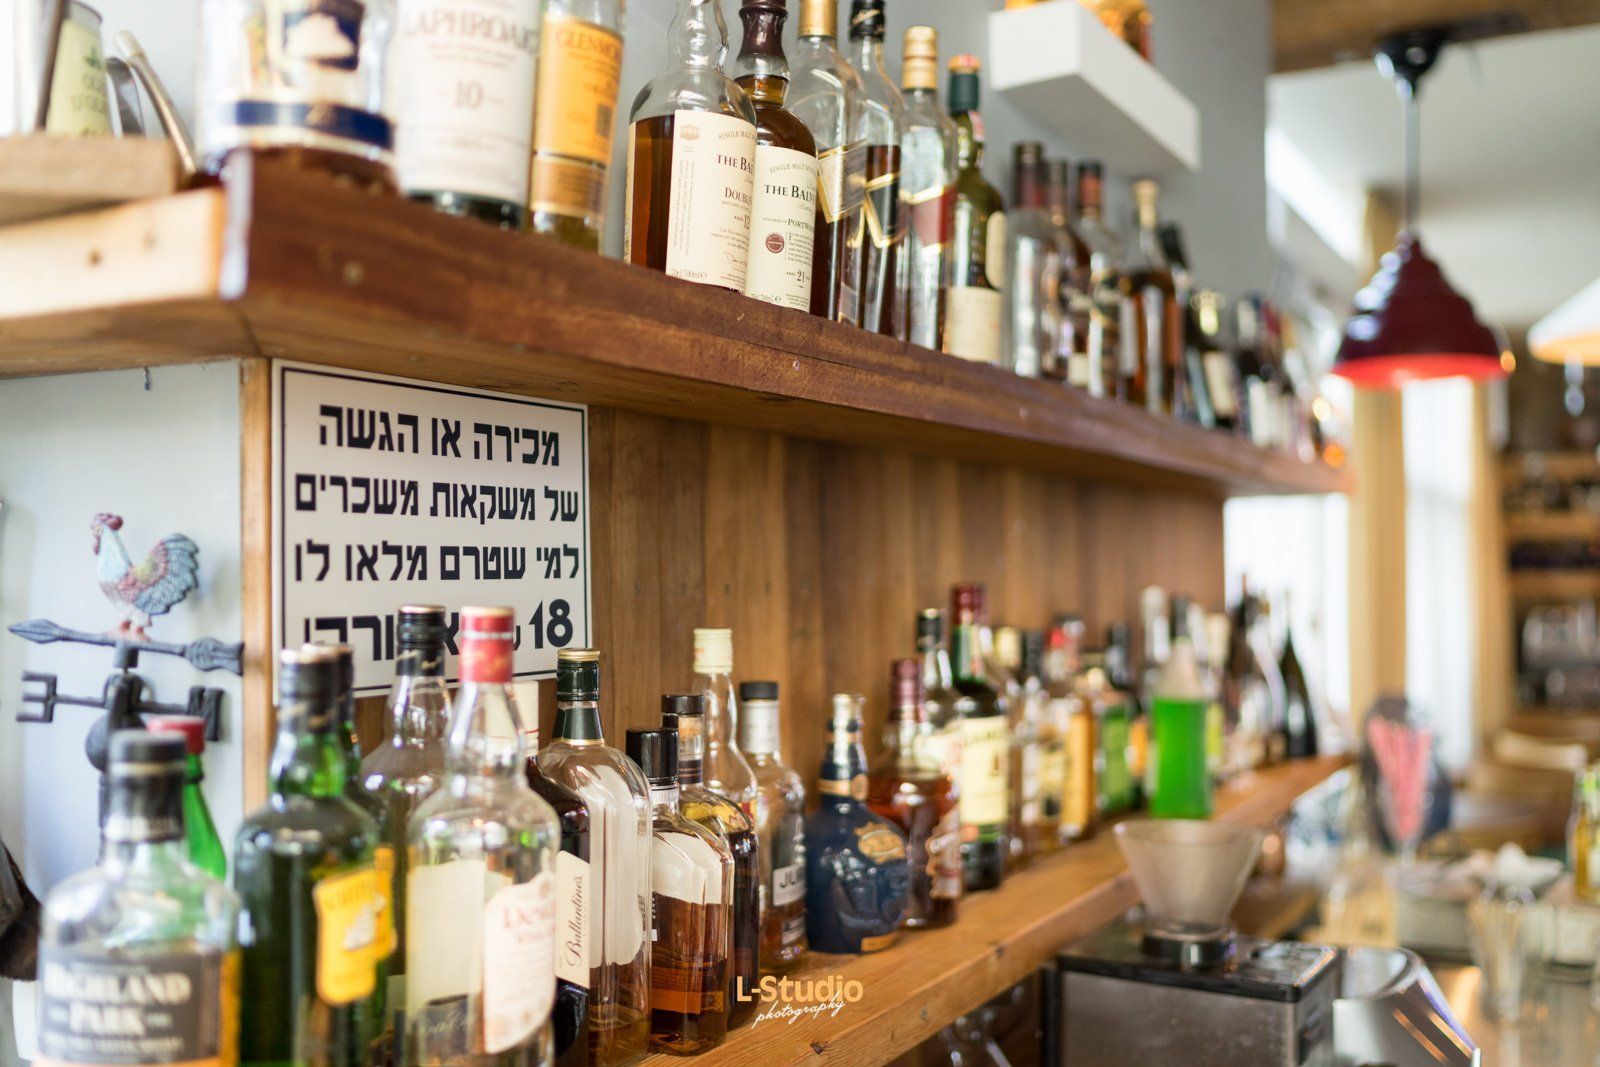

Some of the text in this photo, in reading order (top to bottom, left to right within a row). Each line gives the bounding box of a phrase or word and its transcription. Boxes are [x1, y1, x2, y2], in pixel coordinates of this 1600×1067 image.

[454, 80, 484, 109] 10
[716, 154, 738, 168] THE
[763, 184, 788, 196] THE
[796, 269, 805, 283] 21
[320, 405, 559, 466] מכירה או הגשה
[296, 473, 578, 525] של משקאות משכרים
[295, 539, 579, 582] למי שטרם מלאו לו
[528, 599, 573, 650] 18
[565, 874, 584, 967] Ballantine's
